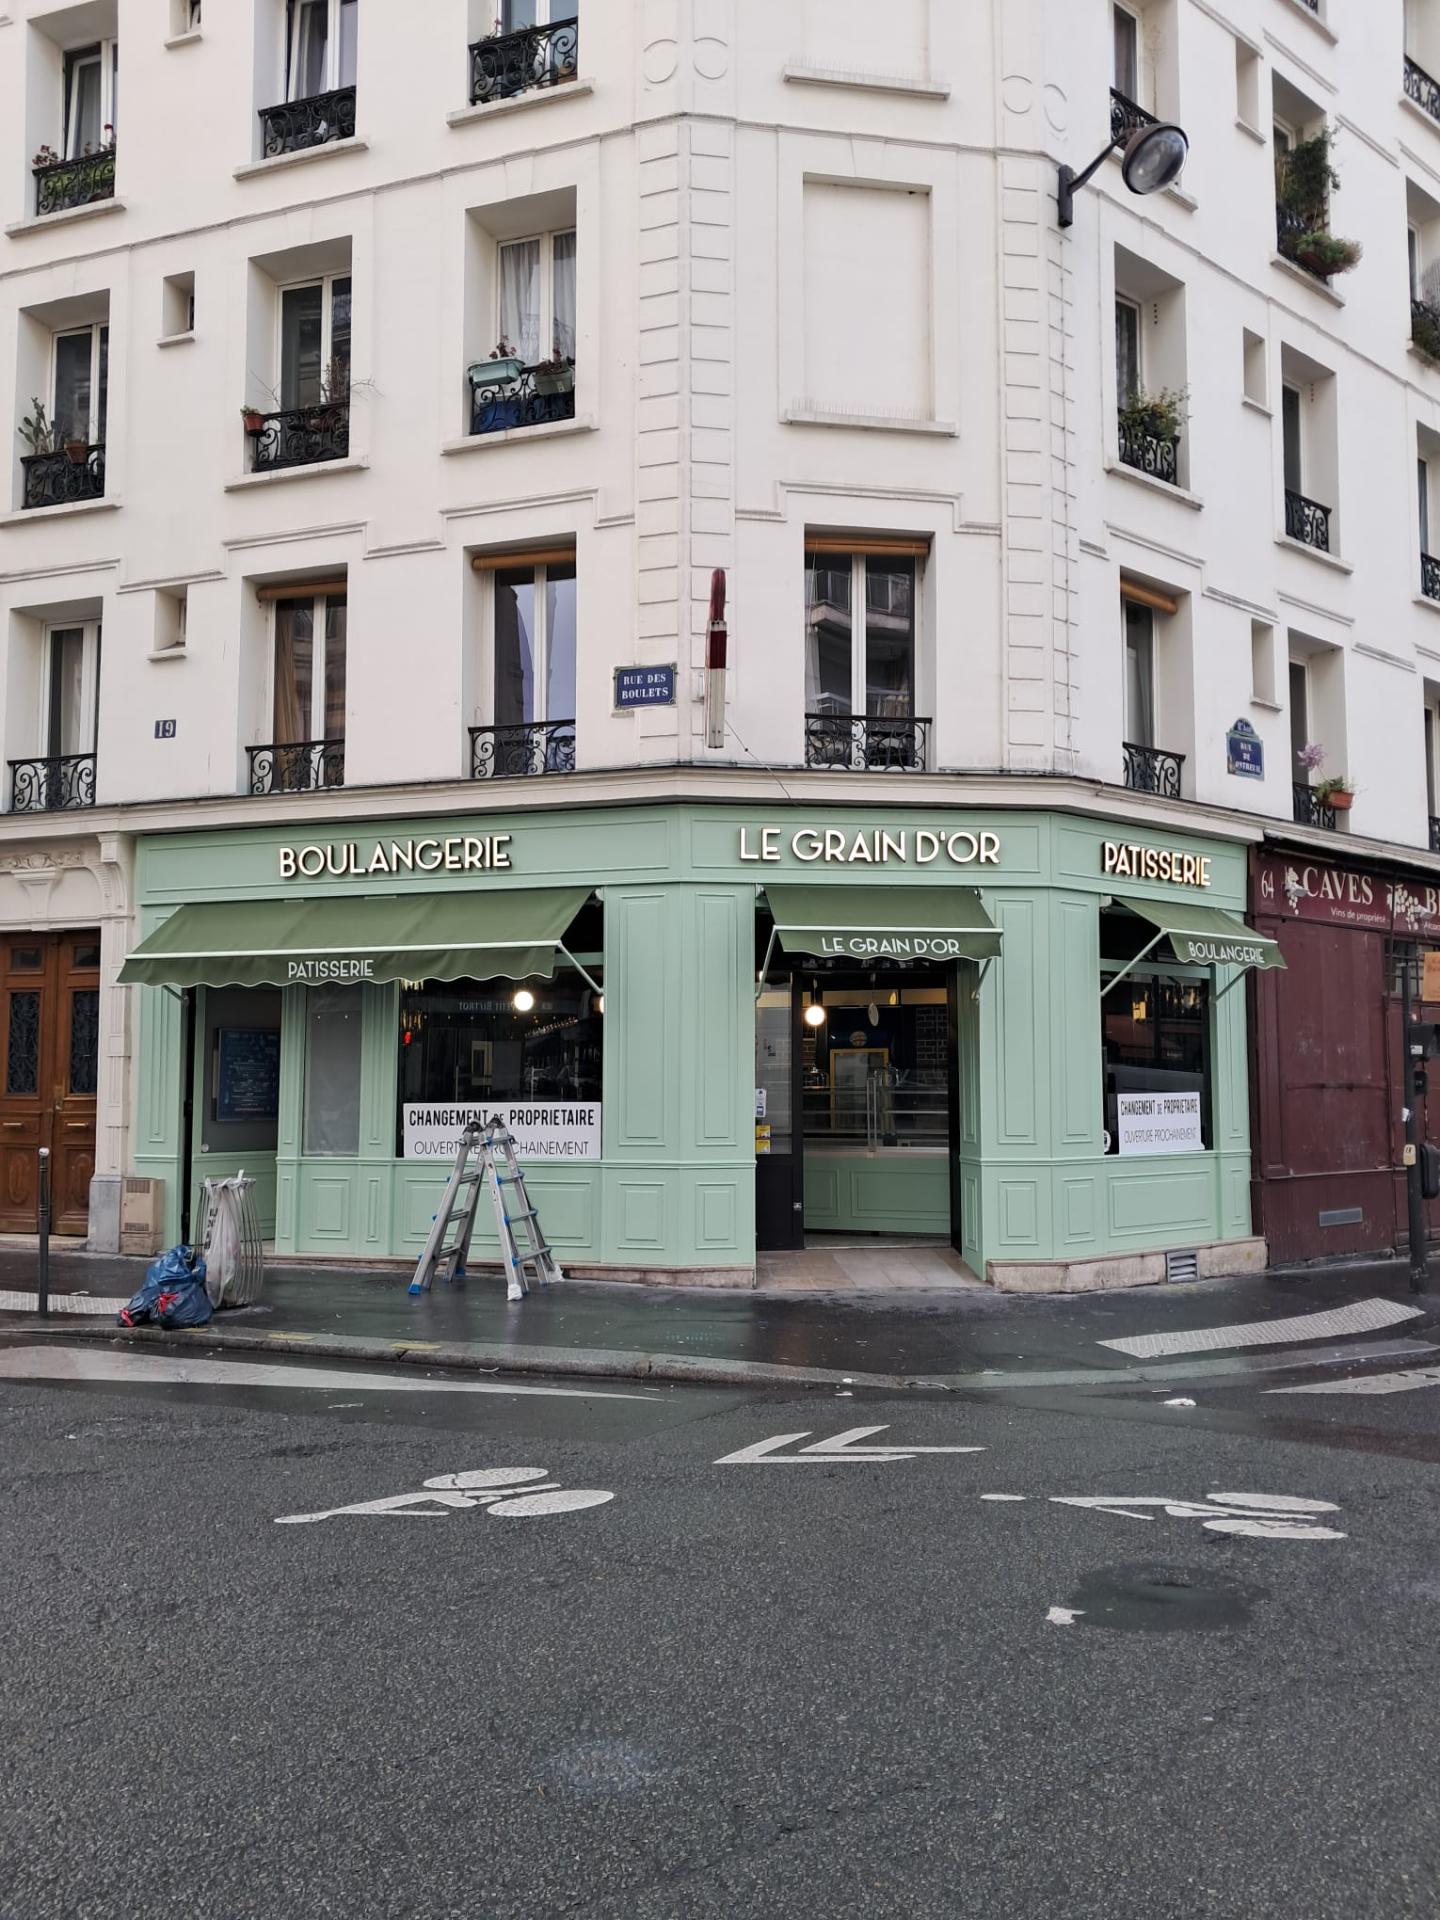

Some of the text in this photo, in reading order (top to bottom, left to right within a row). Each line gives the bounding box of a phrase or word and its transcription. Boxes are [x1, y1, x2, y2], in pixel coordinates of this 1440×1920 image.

[623, 673, 667, 686] RUE DES
[621, 687, 669, 700] BOULETS
[158, 721, 174, 737] 19
[739, 827, 1001, 864] LE GRAIN D'OR
[279, 836, 511, 877] BOULANGERIE
[1103, 841, 1212, 887] PATISSERIE
[1261, 870, 1275, 899] 64
[1303, 866, 1373, 905] CAVES
[1331, 906, 1346, 918] Vins
[1347, 910, 1355, 920] de
[822, 936, 961, 954] LE GRAIN D'OR
[1188, 941, 1265, 964] BOULANGERIE
[288, 959, 374, 979] PATISSERIE
[1120, 1099, 1156, 1116] CHANGEMENT
[1163, 1098, 1198, 1114] PROPRIETAIRE
[409, 1109, 488, 1126] CHANGEMENT
[509, 1108, 595, 1126] PROPRIETAIRE
